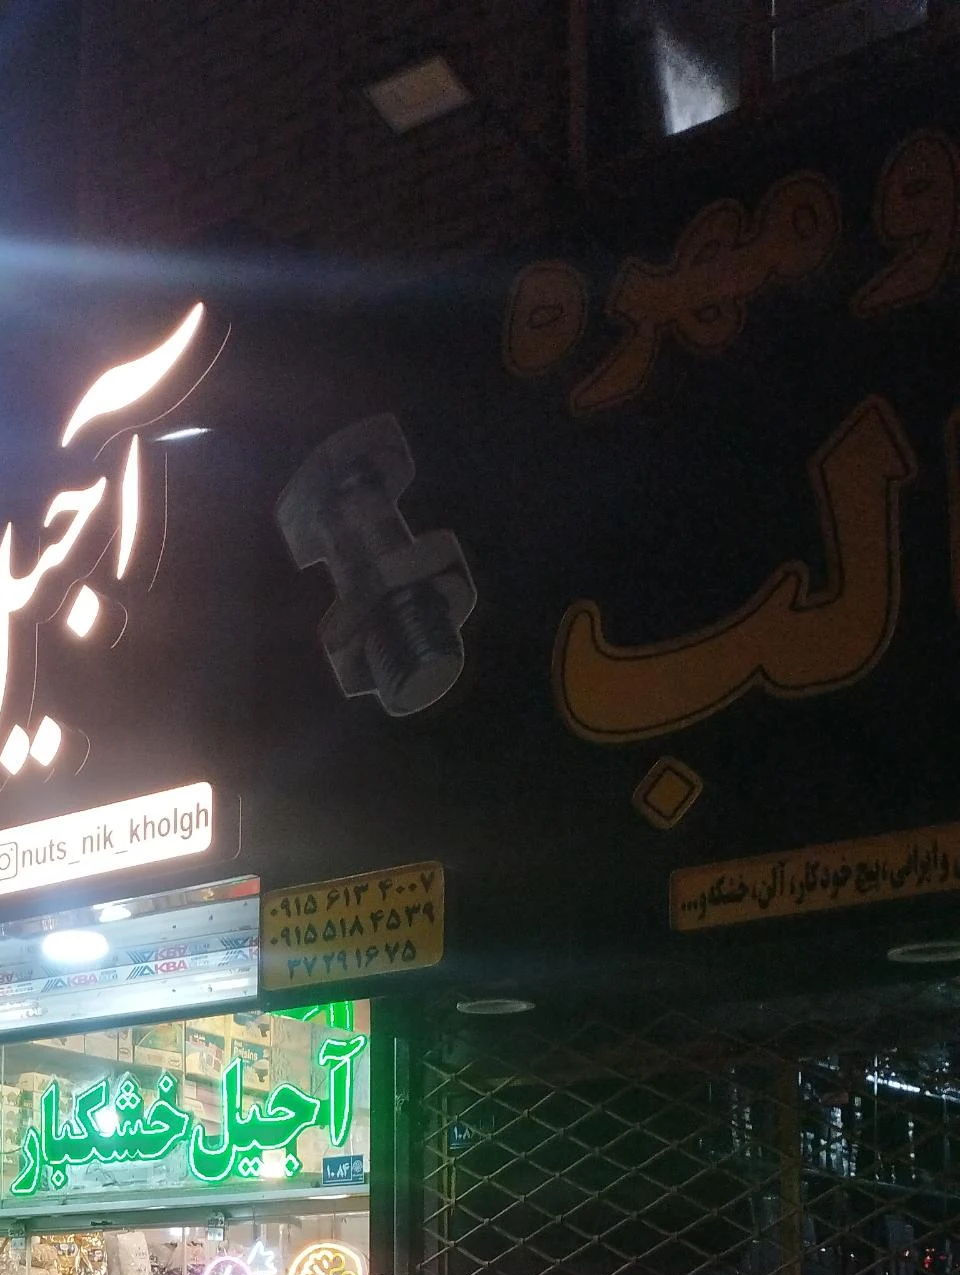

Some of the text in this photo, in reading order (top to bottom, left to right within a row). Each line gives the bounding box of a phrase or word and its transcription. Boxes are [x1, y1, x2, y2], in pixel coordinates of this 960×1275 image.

[21, 803, 209, 867] nuts_nik_kholgh
[10, 1074, 191, 1195] خشکبار
[189, 1035, 368, 1183] آجیل
